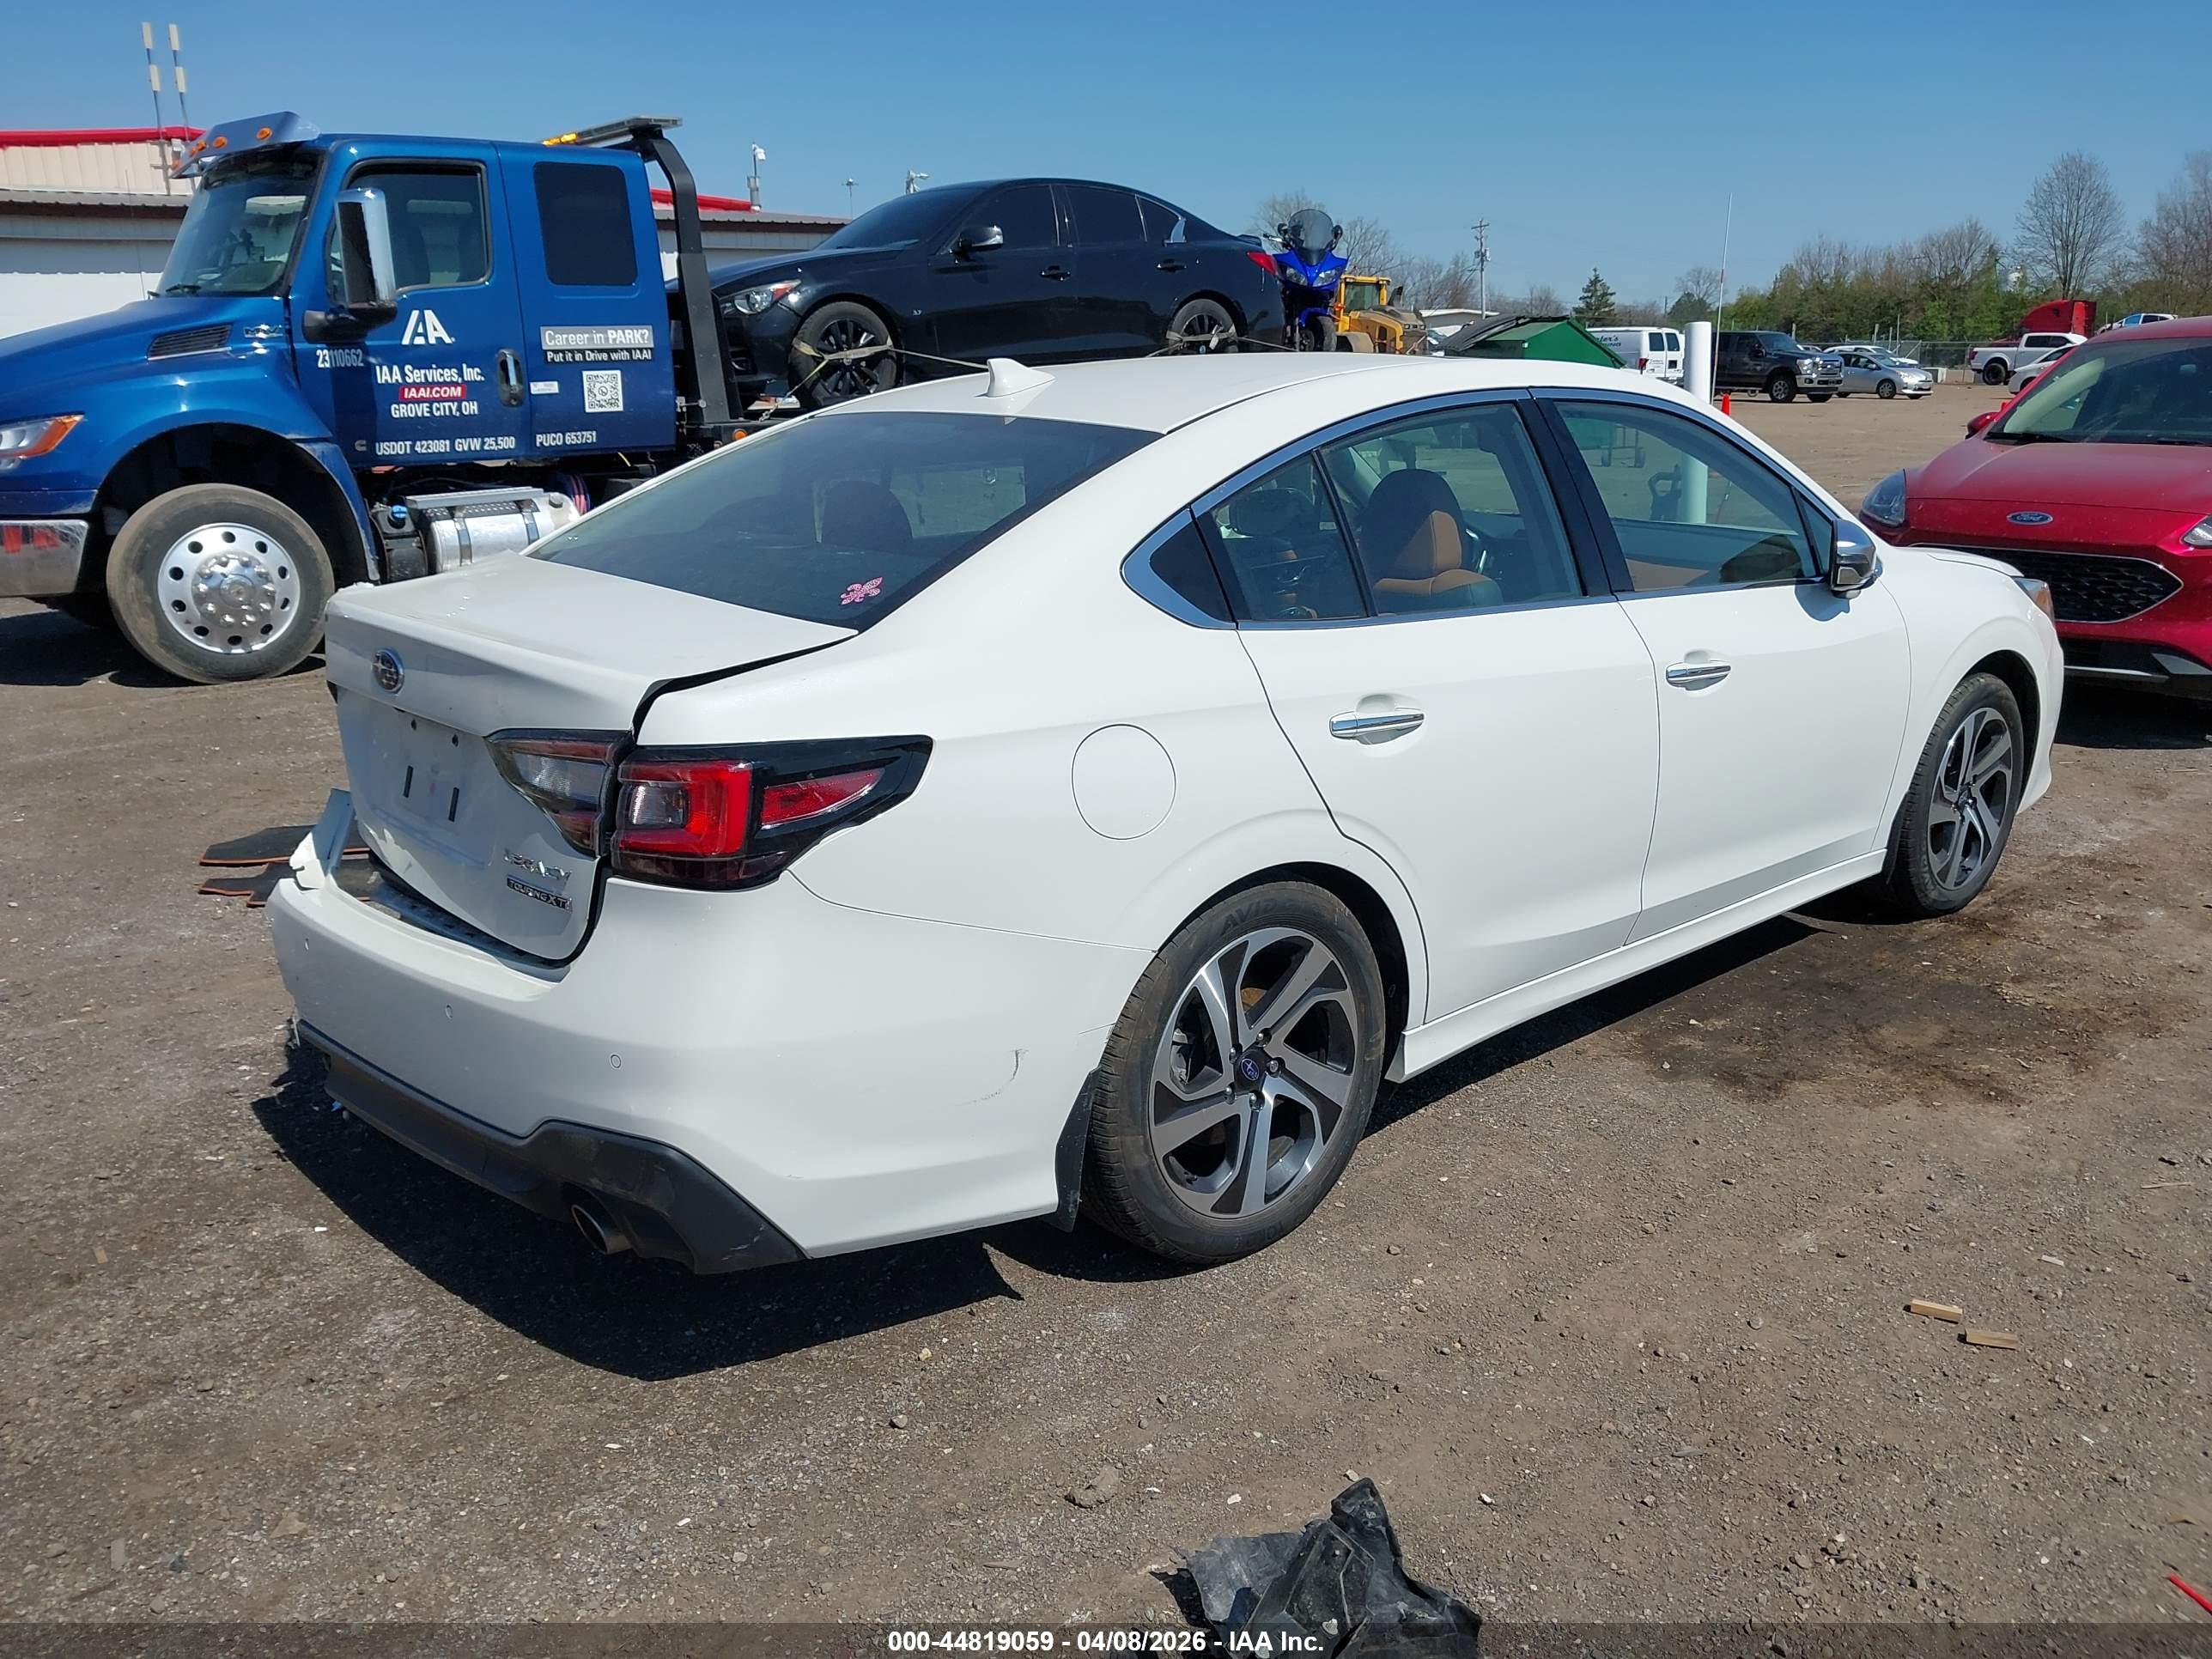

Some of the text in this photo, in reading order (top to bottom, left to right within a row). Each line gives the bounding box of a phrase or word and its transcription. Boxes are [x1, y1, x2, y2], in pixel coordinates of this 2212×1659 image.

[545, 329, 649, 346] Career in PARK?
[316, 348, 364, 368] 23110662
[547, 349, 652, 362] Put it in Drive with IAAI
[376, 362, 485, 384] IAA Services, Inc.
[404, 386, 461, 399] IAAI.COM
[391, 401, 478, 418] GROVE CITY, OH
[375, 436, 516, 455] USDOT 423081 GVW 25,500
[536, 430, 597, 447] PUCO 653751
